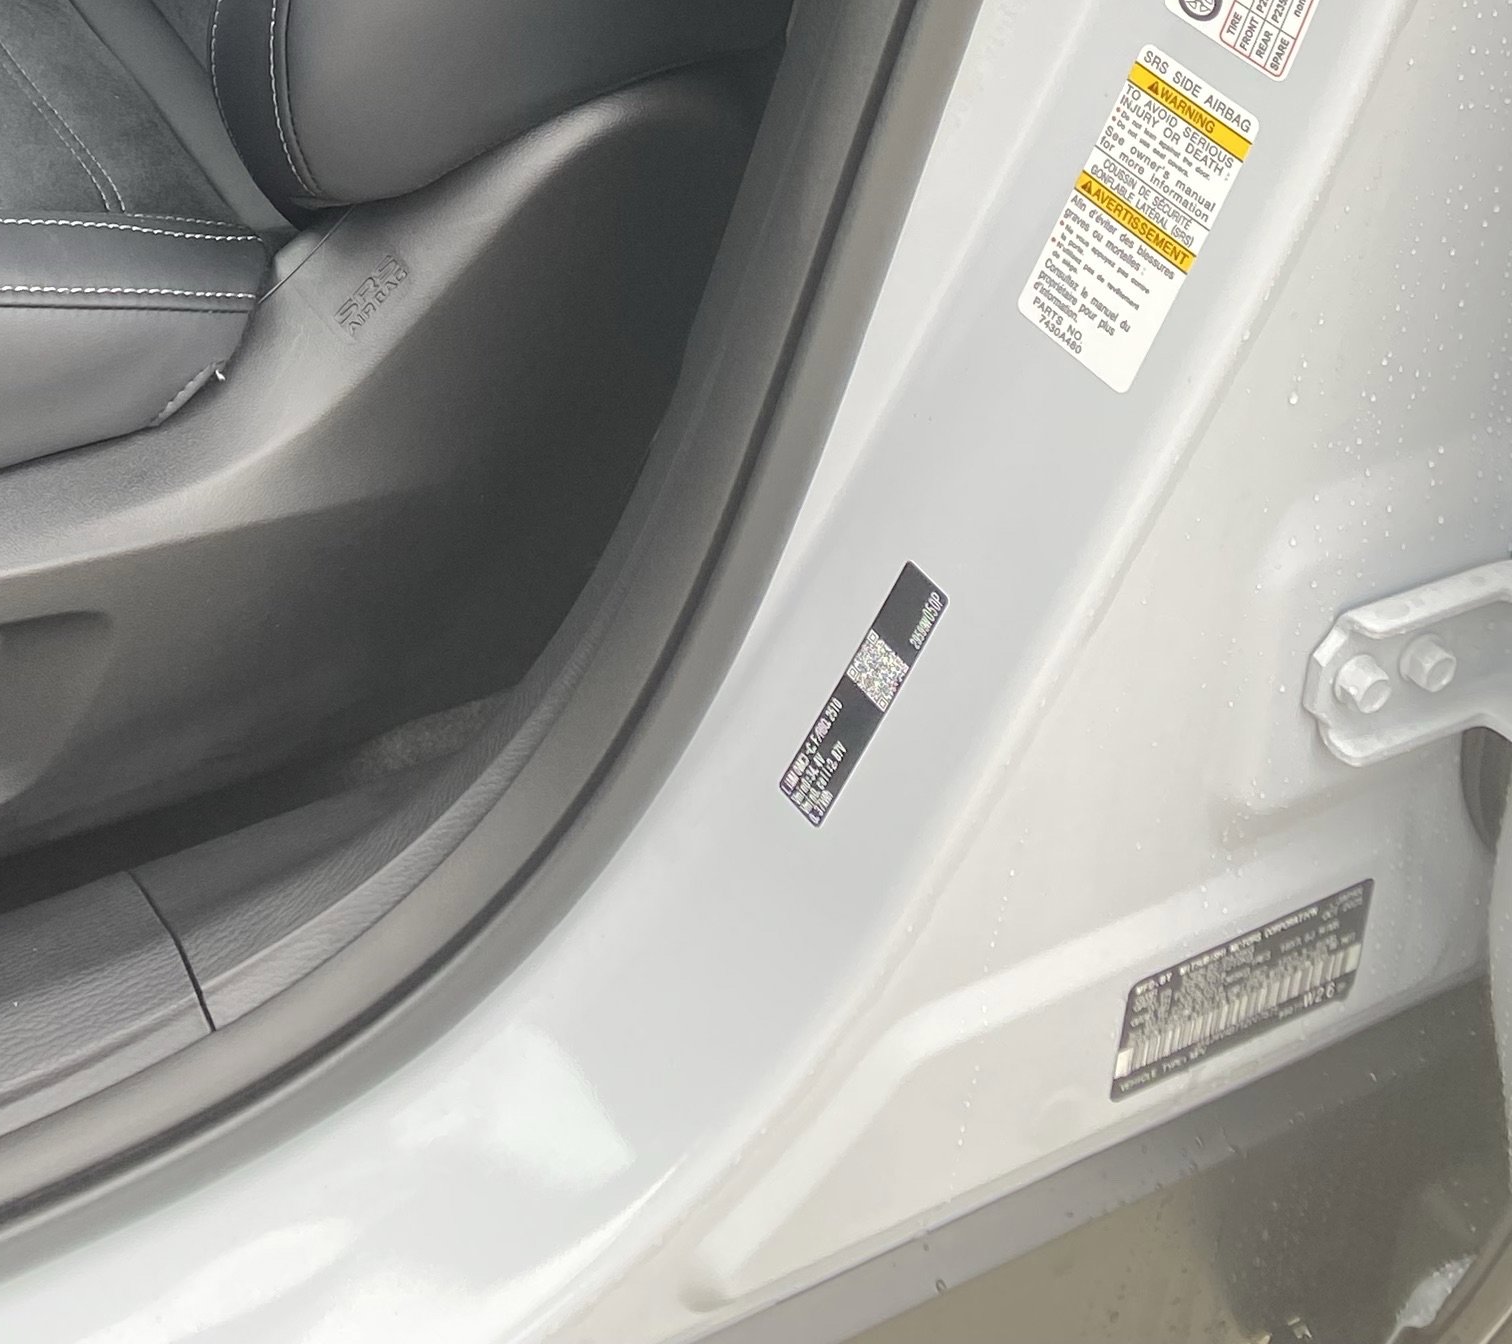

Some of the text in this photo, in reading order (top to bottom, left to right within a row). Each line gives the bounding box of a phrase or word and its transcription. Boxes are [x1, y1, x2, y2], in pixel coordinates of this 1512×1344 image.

[1226, 11, 1243, 36] TIRE
[1239, 16, 1259, 52] FRONT
[1255, 30, 1274, 59] REAR
[1269, 37, 1290, 71] SPARE
[1119, 94, 1160, 128] INJURY
[1162, 127, 1181, 145] OR
[1143, 50, 1252, 134] SRS SIDE AIRBAG
[1160, 86, 1216, 134] WARNING
[1116, 119, 1126, 130] Do
[1127, 128, 1138, 140] not
[1120, 110, 1130, 122] Do
[1131, 119, 1143, 130] not
[1182, 156, 1193, 168] the
[1126, 83, 1142, 101] TO
[1143, 100, 1178, 129] AVOID
[1182, 126, 1234, 169] SERIOUS
[1099, 135, 1116, 152] for
[1119, 151, 1145, 175] more
[1149, 173, 1209, 223] information
[1103, 158, 1138, 190] COUSSIN
[1137, 185, 1152, 201] DE
[1151, 195, 1194, 231] SÉCURITÉ
[1104, 125, 1125, 146] See
[1129, 146, 1170, 180] owner's
[1175, 179, 1217, 213] manual
[1070, 194, 1087, 212] Afin
[1088, 209, 1118, 235] d'éviter
[1119, 233, 1135, 249] des
[1136, 244, 1175, 280] blessures
[1090, 164, 1136, 203] GONFLABLE
[1135, 198, 1169, 231] LATÉRAL
[1170, 224, 1195, 248] (SRS)
[1091, 188, 1190, 265] AVERTISSEMENT
[1063, 207, 1090, 232] graves
[1092, 229, 1104, 243] ou
[1105, 239, 1141, 272] mortelles
[334, 254, 399, 325] SRS
[1032, 295, 1064, 326] PARTS
[1037, 270, 1116, 336] propriétaire pour plus
[1044, 257, 1080, 292] Consultez
[1080, 286, 1089, 299] le
[1090, 296, 1119, 323] manuel
[1119, 319, 1131, 333] du
[1038, 313, 1082, 354] 7430A480
